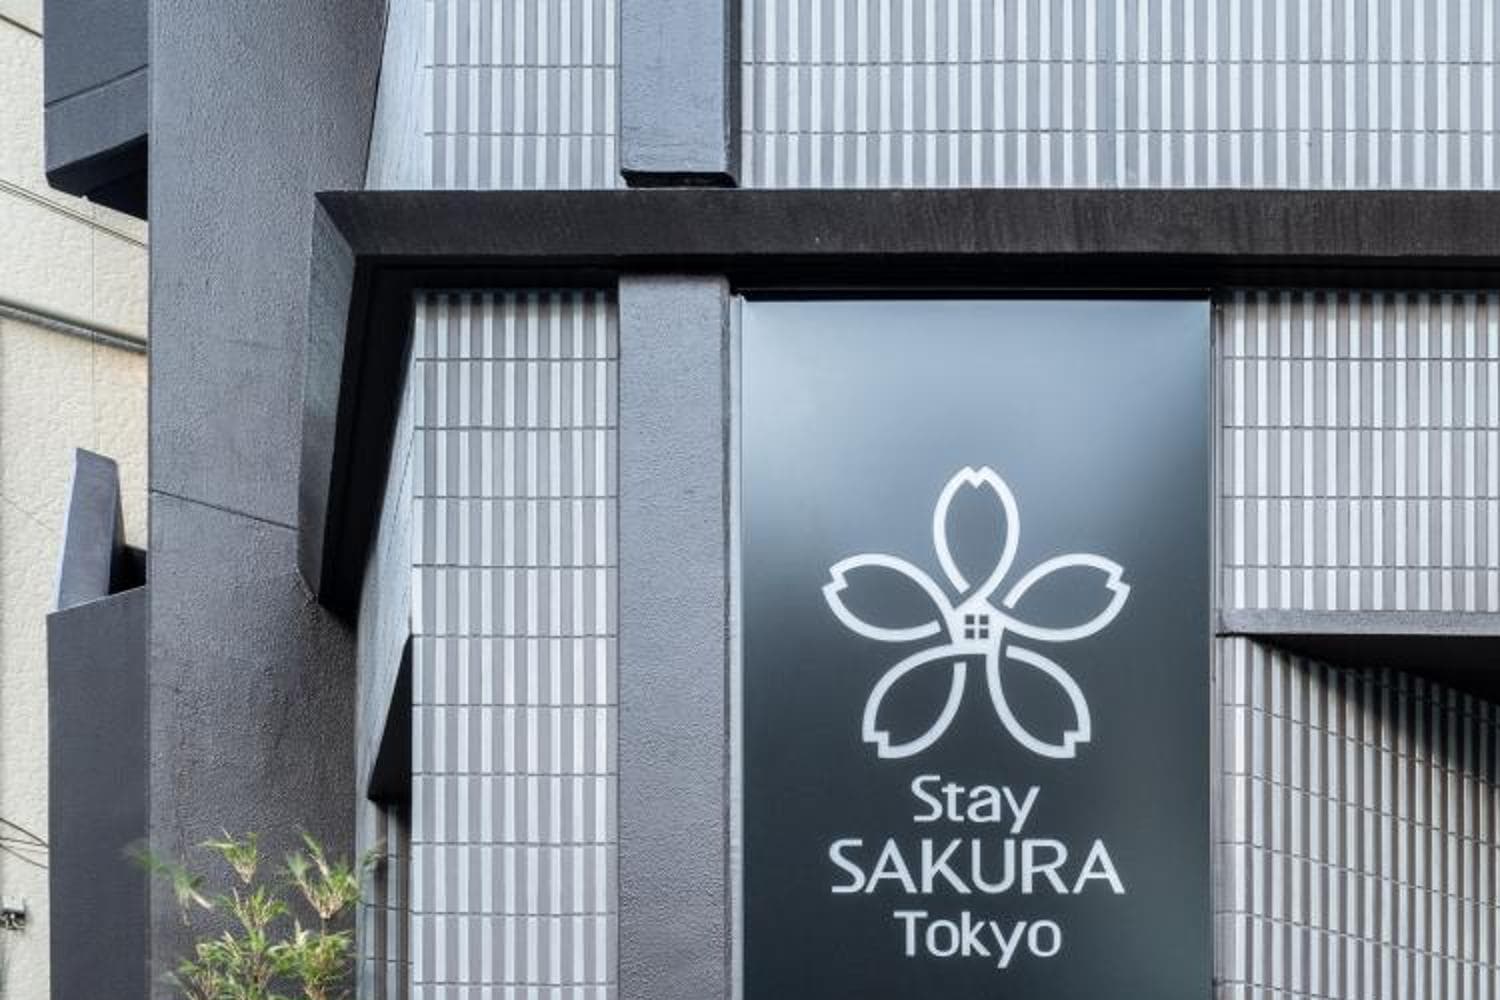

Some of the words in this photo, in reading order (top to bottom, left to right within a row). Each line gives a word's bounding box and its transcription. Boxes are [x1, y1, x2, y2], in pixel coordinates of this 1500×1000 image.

[911, 775, 1040, 834] Stay
[829, 839, 1125, 894] SAKURA
[893, 911, 1062, 969] Tokyo
